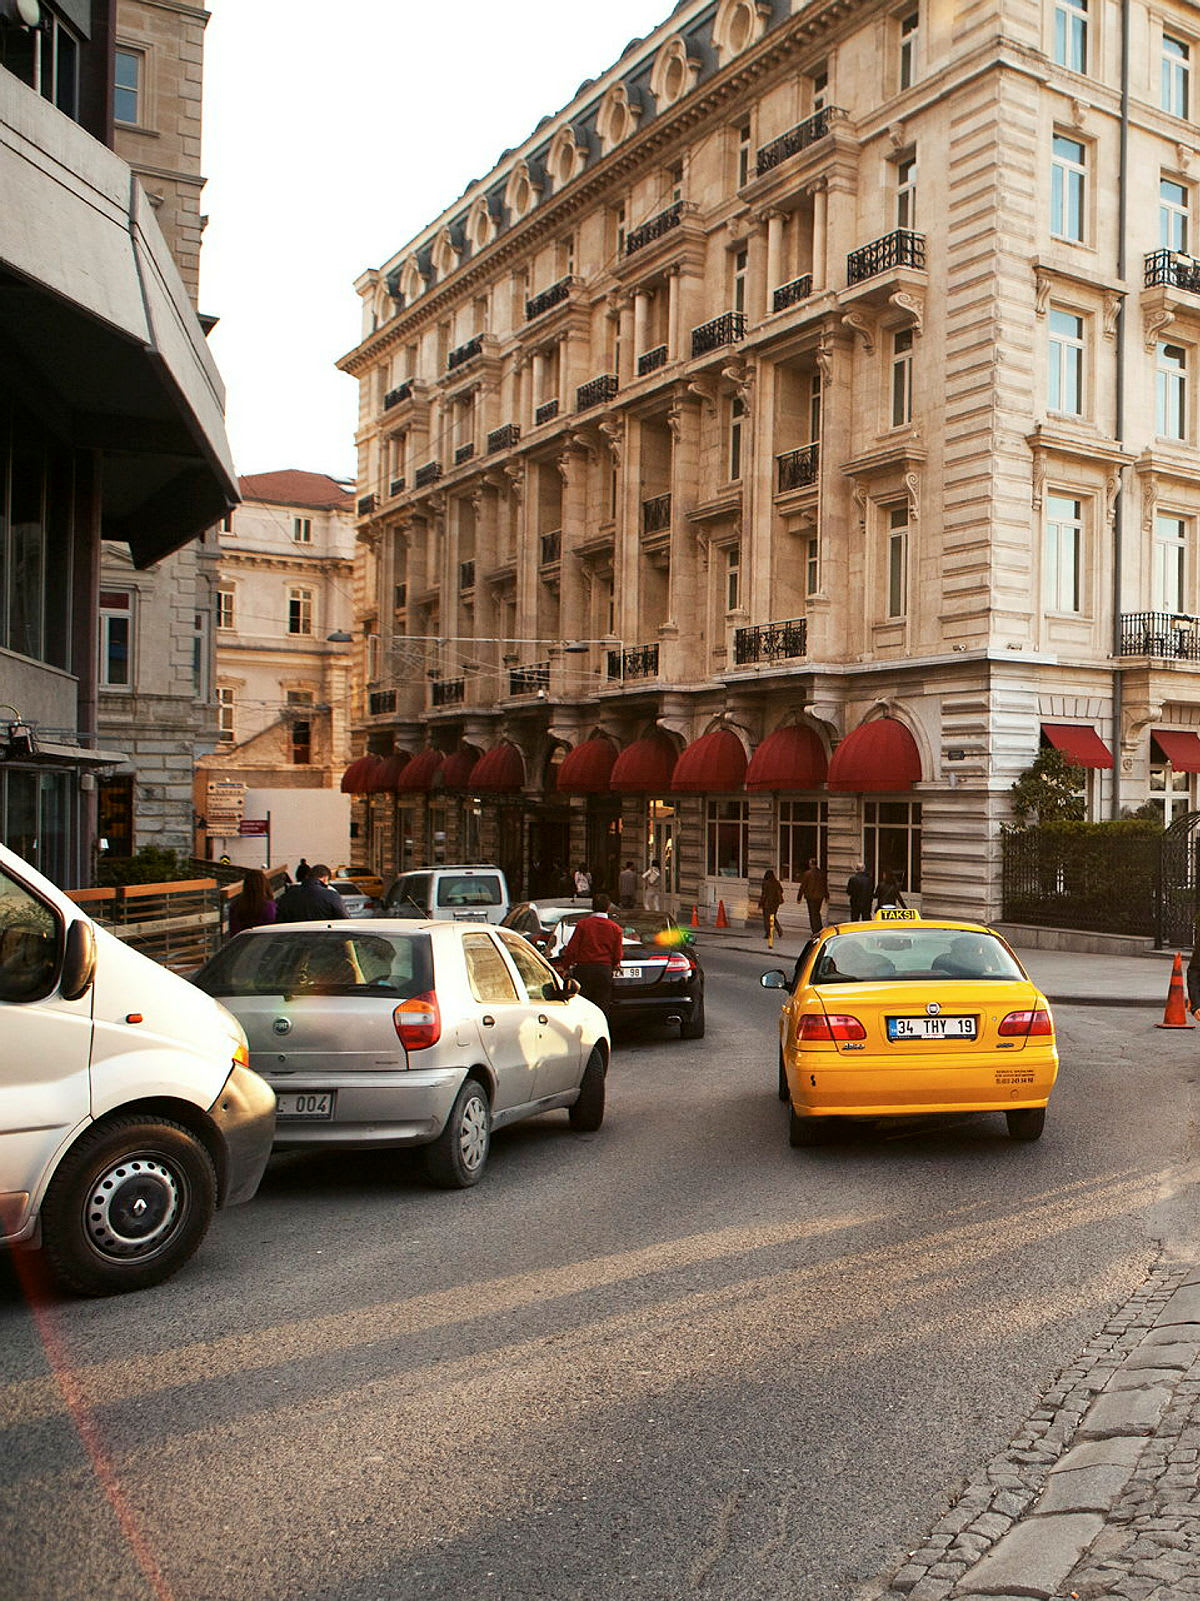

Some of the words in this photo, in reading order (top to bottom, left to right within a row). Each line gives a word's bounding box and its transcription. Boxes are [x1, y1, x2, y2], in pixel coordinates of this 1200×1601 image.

[898, 1021, 913, 1034] 34
[924, 1020, 946, 1034] THY
[958, 1020, 972, 1033] 19
[296, 1096, 327, 1112] 004
